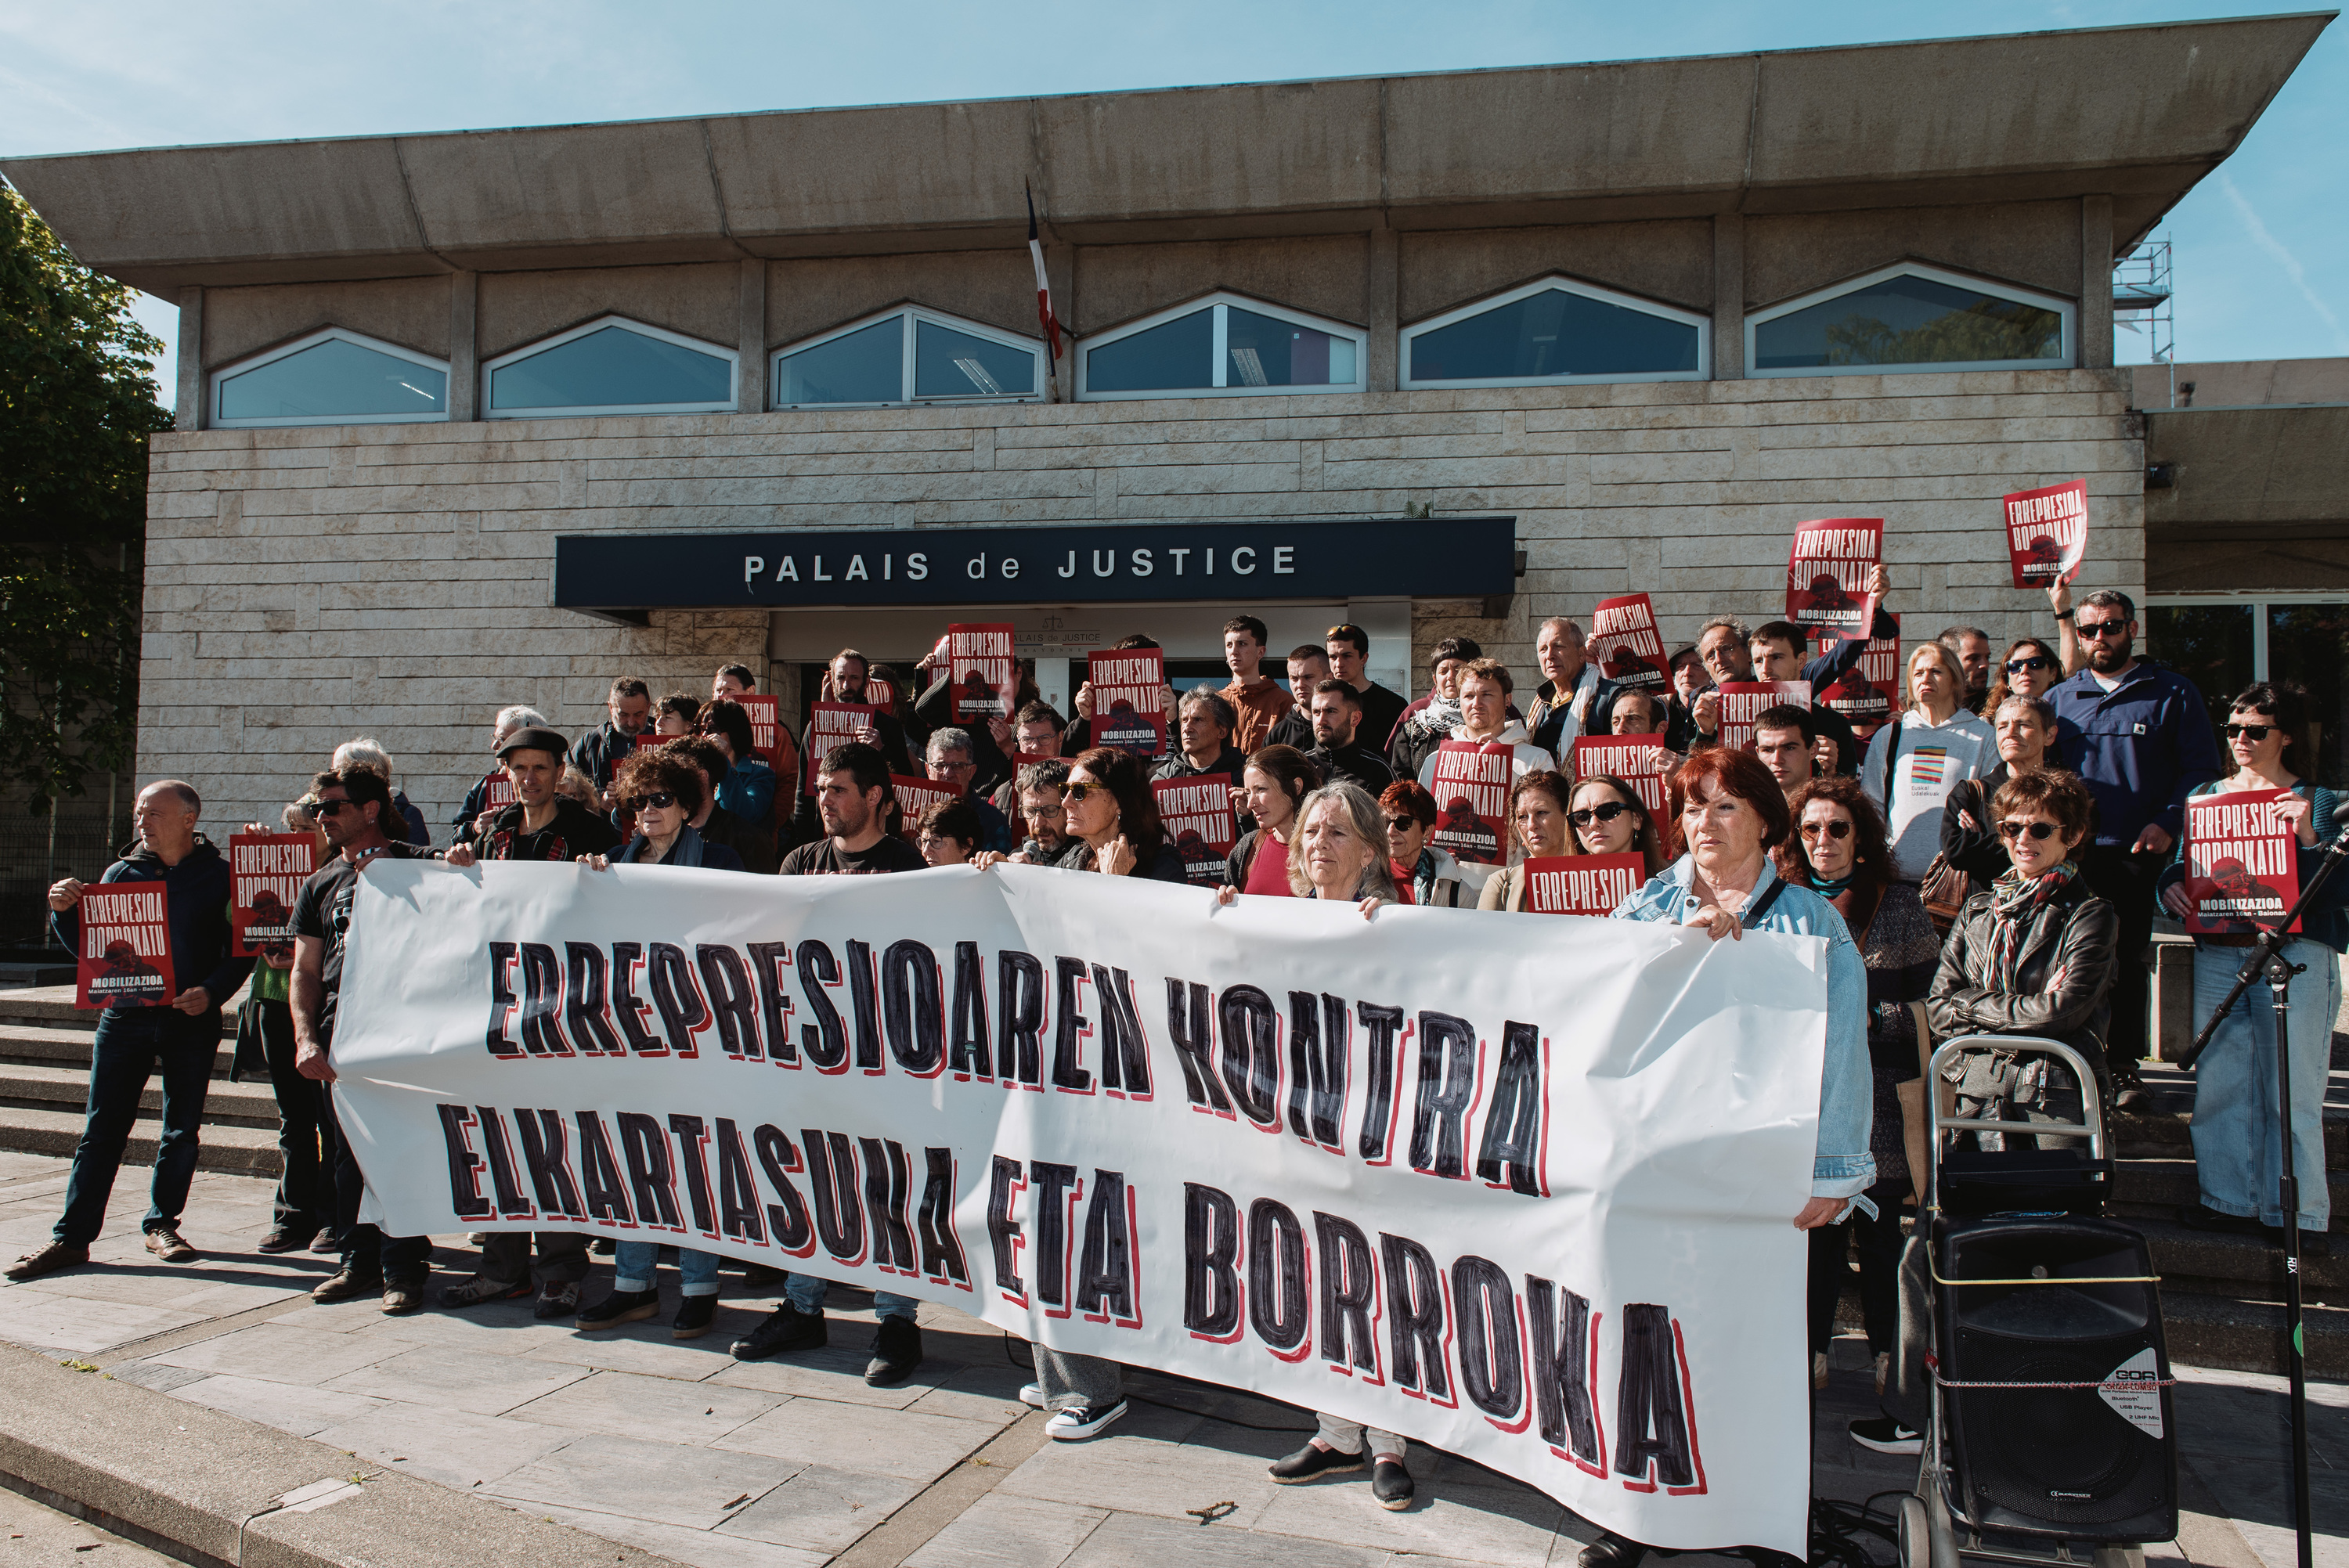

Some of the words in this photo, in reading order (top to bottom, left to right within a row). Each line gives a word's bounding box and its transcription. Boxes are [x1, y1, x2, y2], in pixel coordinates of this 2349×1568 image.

[2008, 489, 2083, 525] ERREPRESIOA
[1795, 529, 1876, 558] ERREPRESIOA
[745, 553, 929, 582] PALAIS
[967, 552, 1019, 579] de
[1058, 546, 1295, 578] JUSTICE
[2023, 562, 2065, 572] MOBILIZA
[1593, 603, 1652, 636] ERREPRESIOA
[1798, 609, 1862, 620] MOBILIZAZIOA
[951, 632, 1010, 657] ERREPRESIOA
[1062, 633, 1101, 642] JUSTICE
[1092, 658, 1160, 686] ERREPRESIOA
[958, 699, 1005, 708] MOBILIZAZIOA
[1829, 697, 1888, 708] MOBILIZAZIOA
[1101, 729, 1156, 740] MOBILIZAZIOA
[1437, 751, 1507, 784] ERREPRESIOA
[1157, 783, 1229, 816] ERREPRESIOA
[1434, 830, 1496, 845] MOBILIZAZIOA
[235, 844, 312, 874] ERREPRESIOA
[237, 876, 310, 908] BOROKAT
[1531, 867, 1637, 911] ERREPRESIOA
[82, 892, 164, 924] ERREPRESIOA
[2199, 897, 2283, 910] MOBILIZAZIOA
[92, 975, 164, 988] MOBILIZAZIOA
[485, 939, 1154, 1102] ERREPRESIOAREN
[1164, 977, 1552, 1199] KONTRA
[2287, 1256, 2298, 1274] RTX
[436, 1103, 973, 1292] ELKARTASUNA
[987, 1154, 1143, 1330] ETA
[1183, 1182, 1709, 1496] BORROKA
